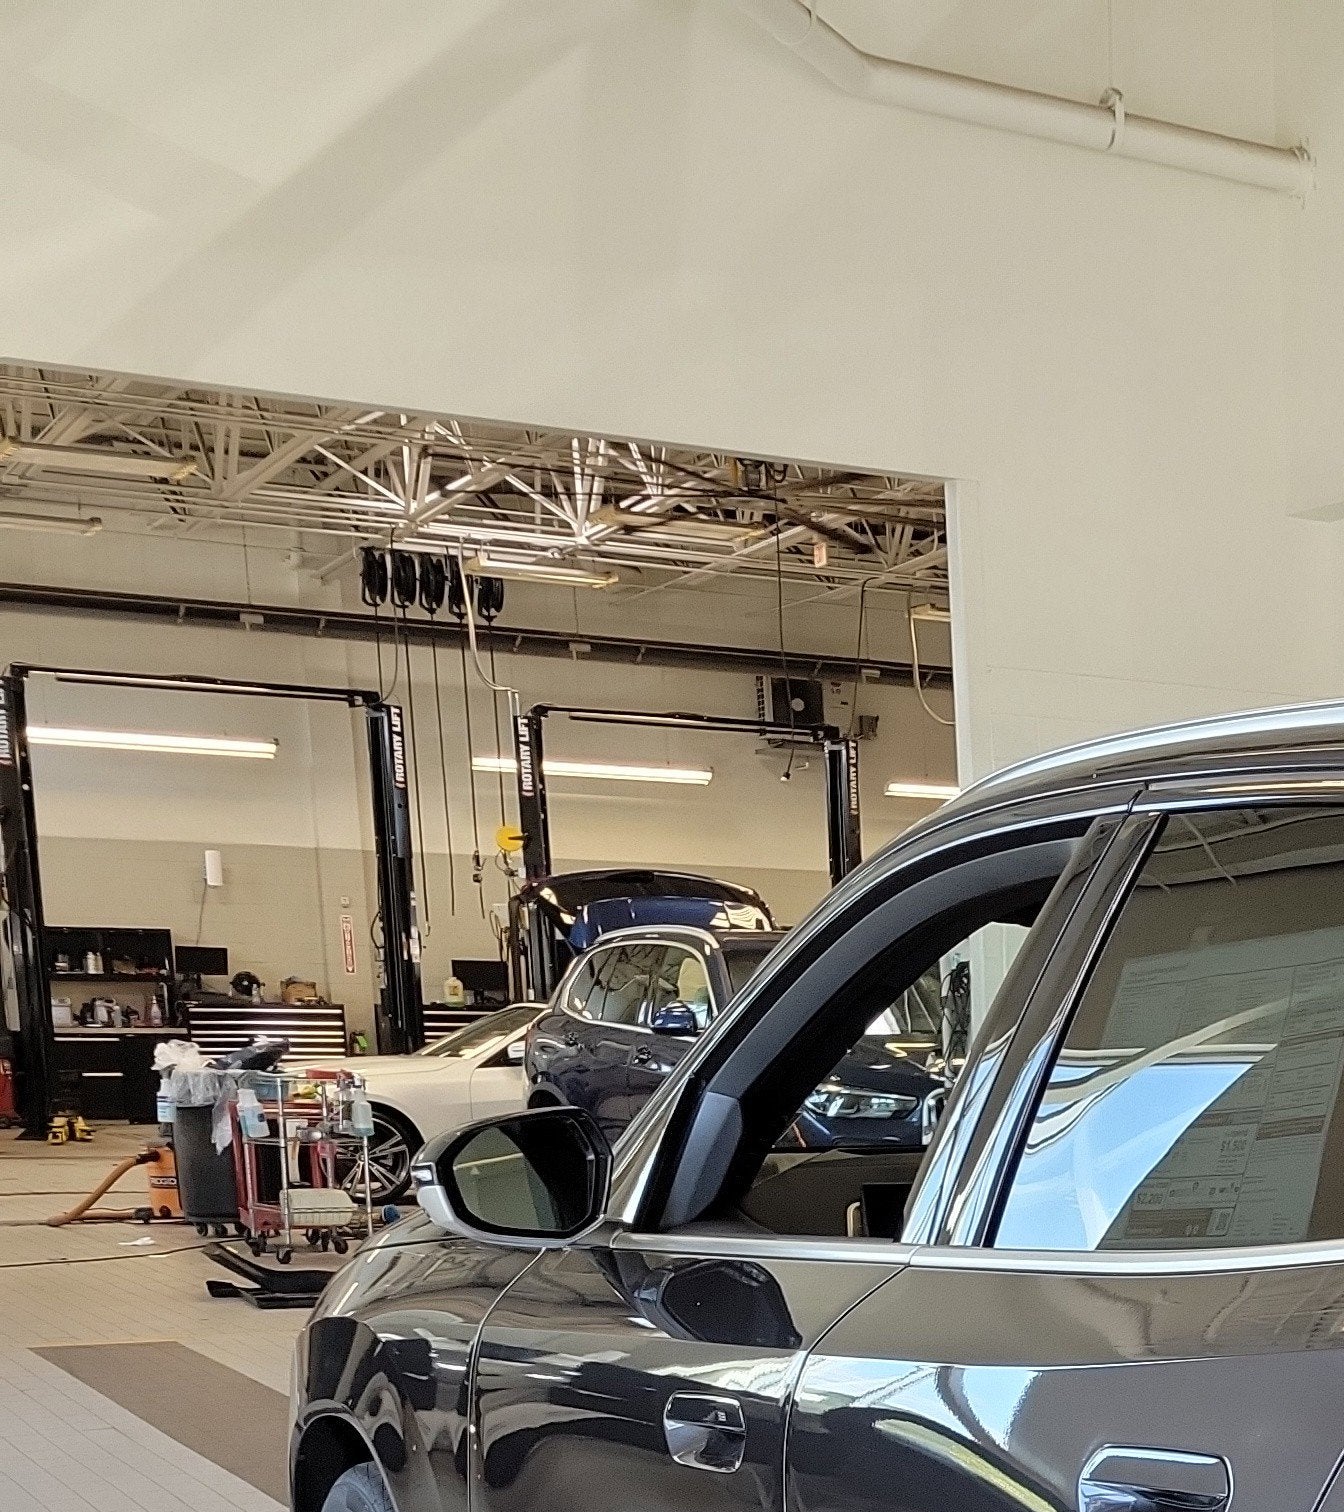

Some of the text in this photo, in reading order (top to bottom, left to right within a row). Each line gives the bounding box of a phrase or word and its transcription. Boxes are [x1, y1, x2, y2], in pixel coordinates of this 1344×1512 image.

[390, 706, 405, 782] ROTARY LIFT
[518, 717, 534, 789] ROTARY LIFT
[848, 740, 858, 809] ROTARY LIFT
